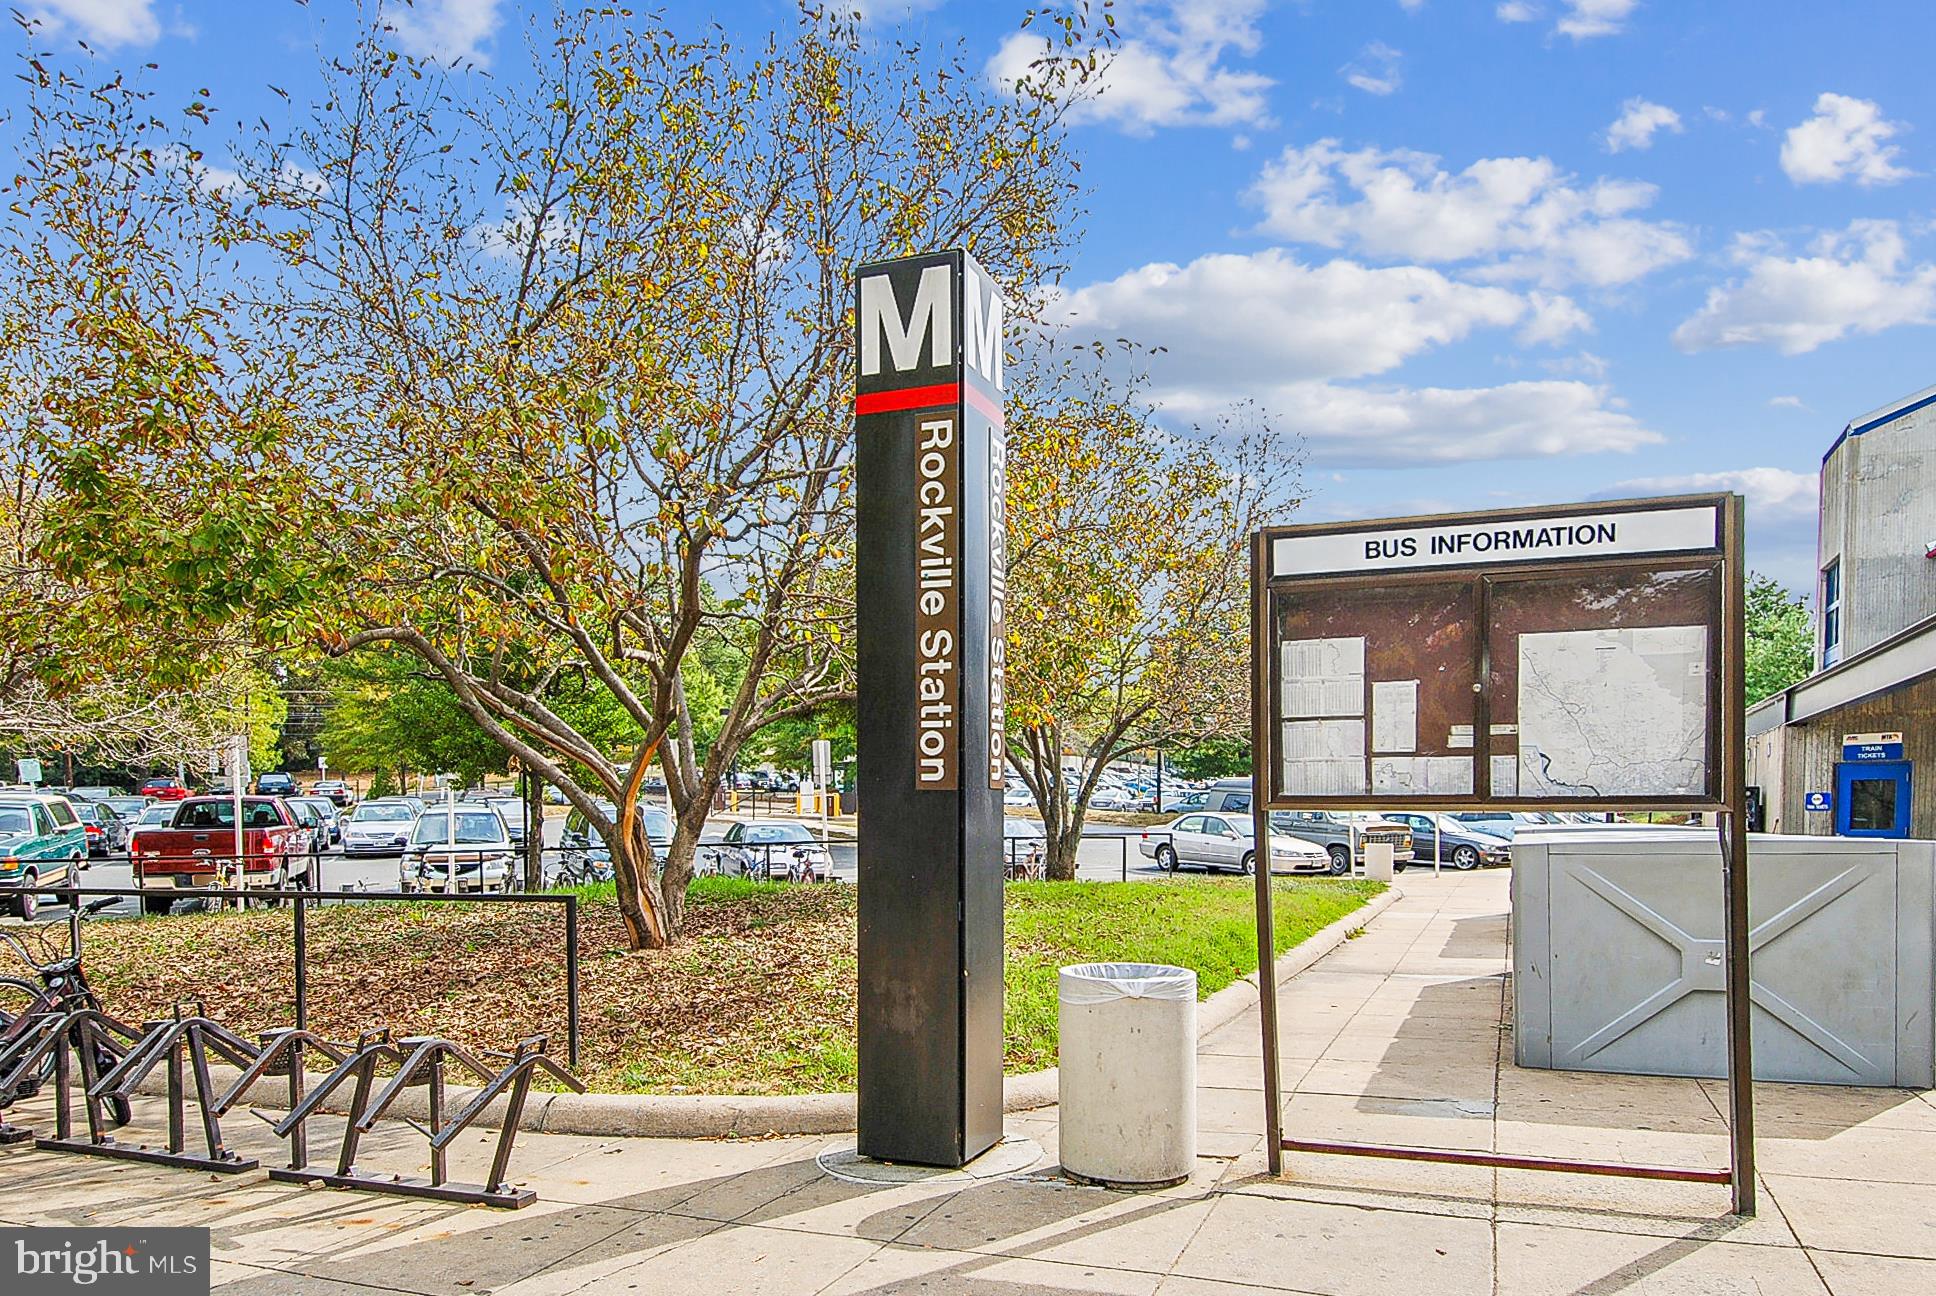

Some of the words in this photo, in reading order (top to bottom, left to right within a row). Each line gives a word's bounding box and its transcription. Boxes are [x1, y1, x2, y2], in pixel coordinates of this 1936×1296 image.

[861, 264, 952, 376] M
[967, 264, 1004, 393] M
[920, 419, 953, 616] Rockville
[991, 438, 1005, 622] Rockville
[1364, 537, 1418, 560] BUS
[1430, 523, 1617, 555] INFORMATION
[920, 630, 953, 781] Station
[991, 636, 1005, 780] Station
